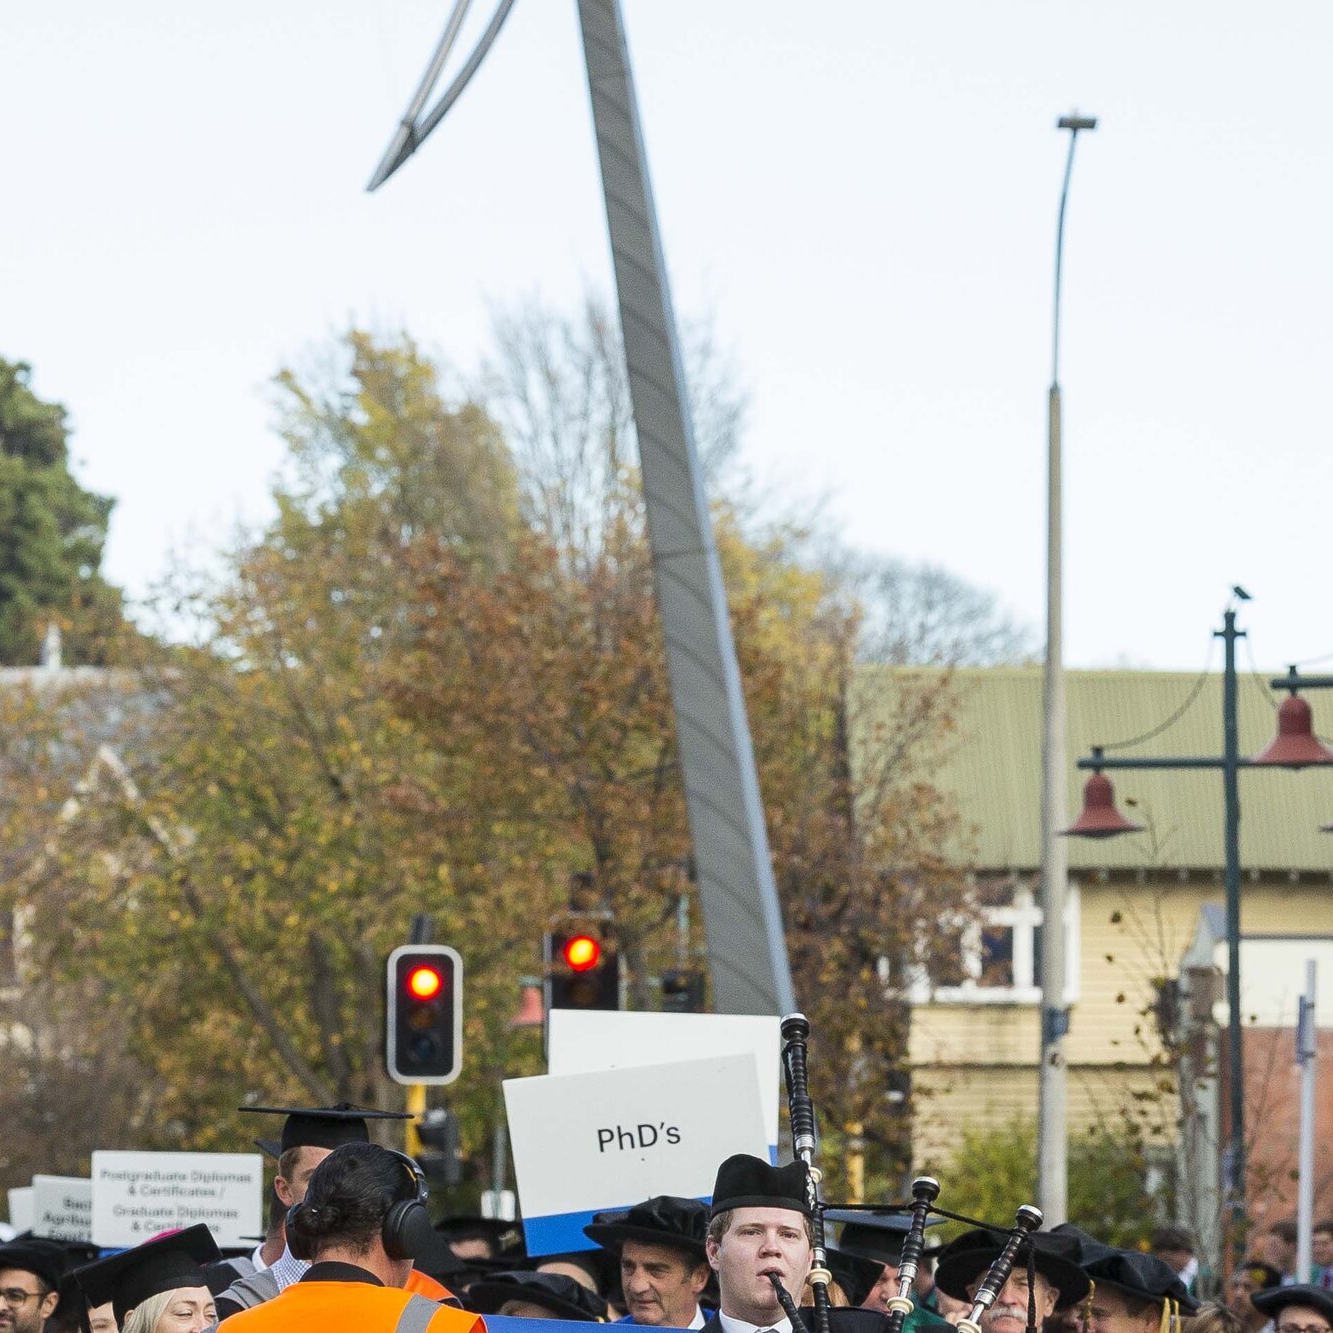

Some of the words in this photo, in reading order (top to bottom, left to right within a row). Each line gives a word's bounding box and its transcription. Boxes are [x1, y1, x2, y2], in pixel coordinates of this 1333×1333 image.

[597, 1121, 681, 1153] PhD's
[100, 1168, 187, 1184] Postgraduate
[191, 1170, 253, 1185] Diplomas
[139, 1185, 216, 1197] Certificates
[113, 1205, 172, 1219] Graduate
[176, 1205, 239, 1219] Diplomas
